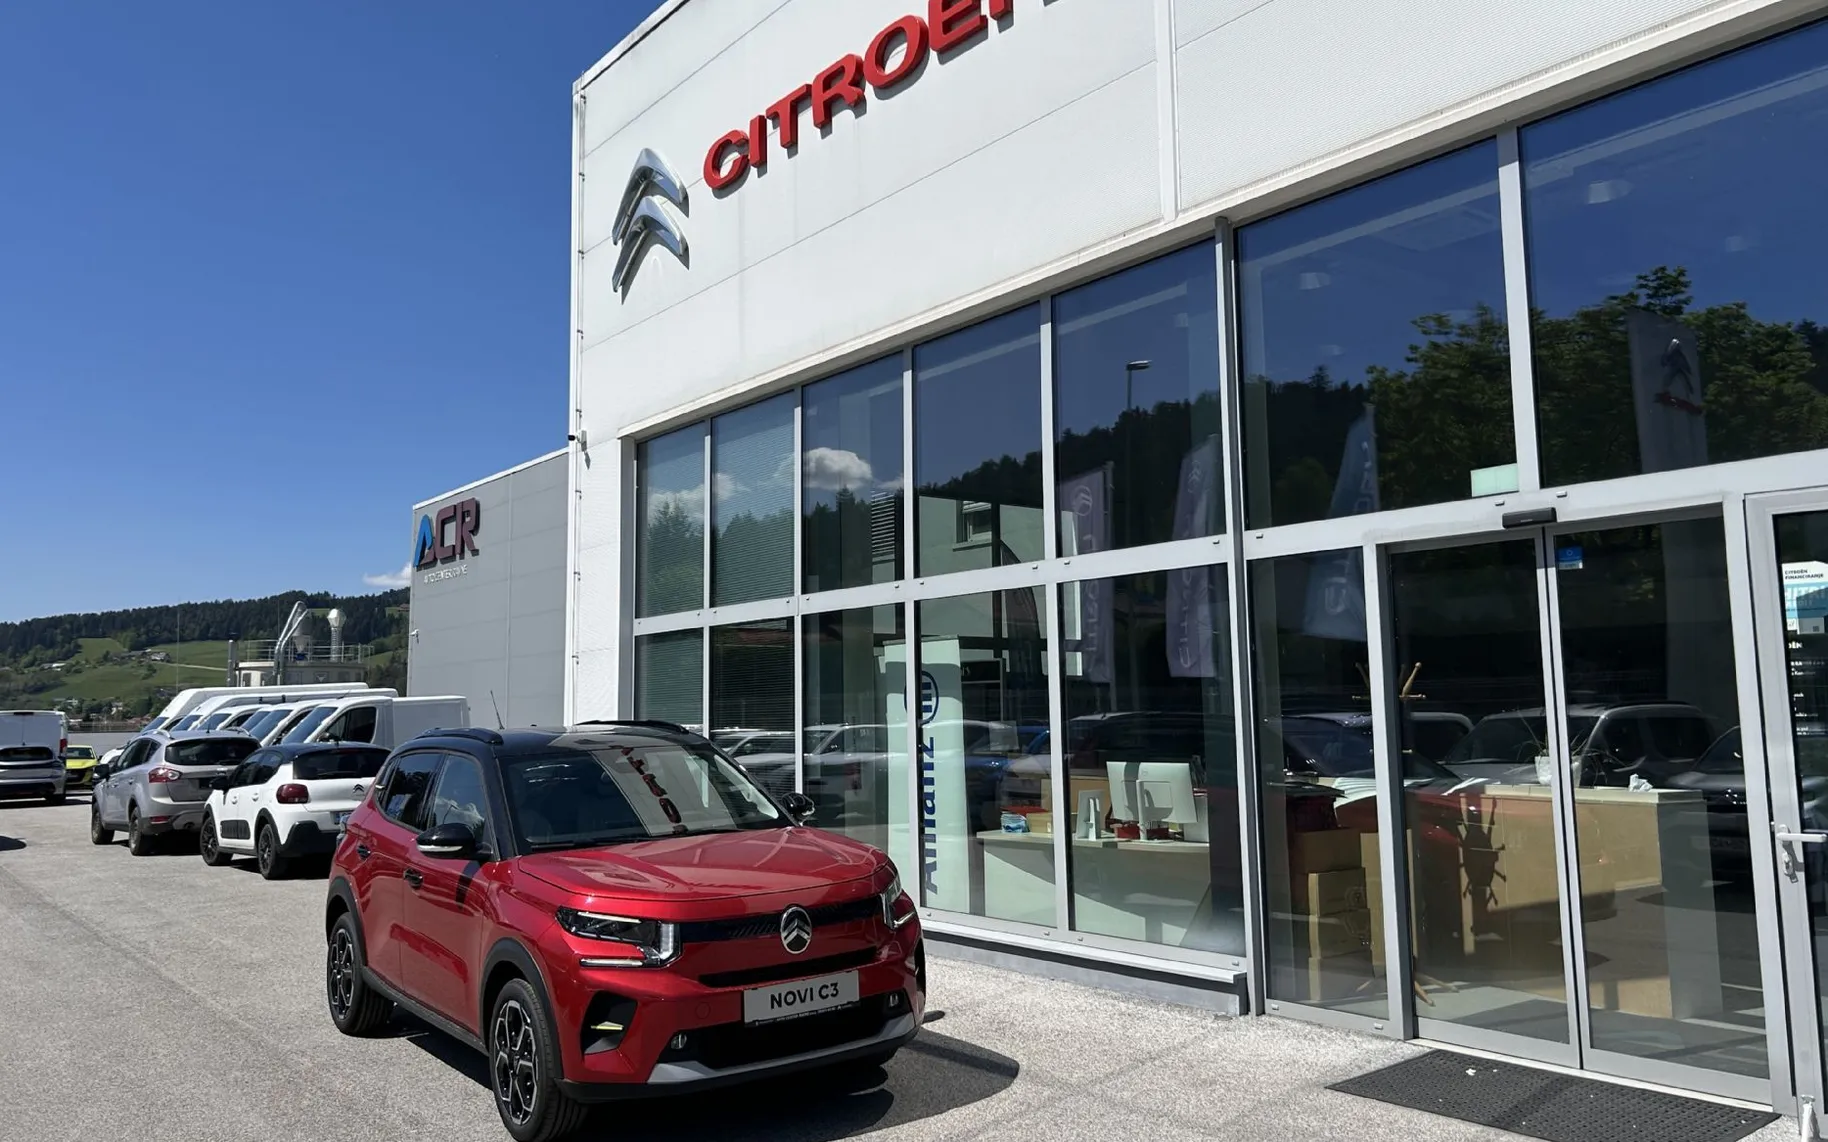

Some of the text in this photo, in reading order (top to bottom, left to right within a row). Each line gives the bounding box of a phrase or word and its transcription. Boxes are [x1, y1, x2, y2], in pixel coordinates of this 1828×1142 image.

[702, 0, 1014, 191] CITROE
[413, 497, 480, 568] ACR
[770, 982, 839, 1010] NOVI C3
